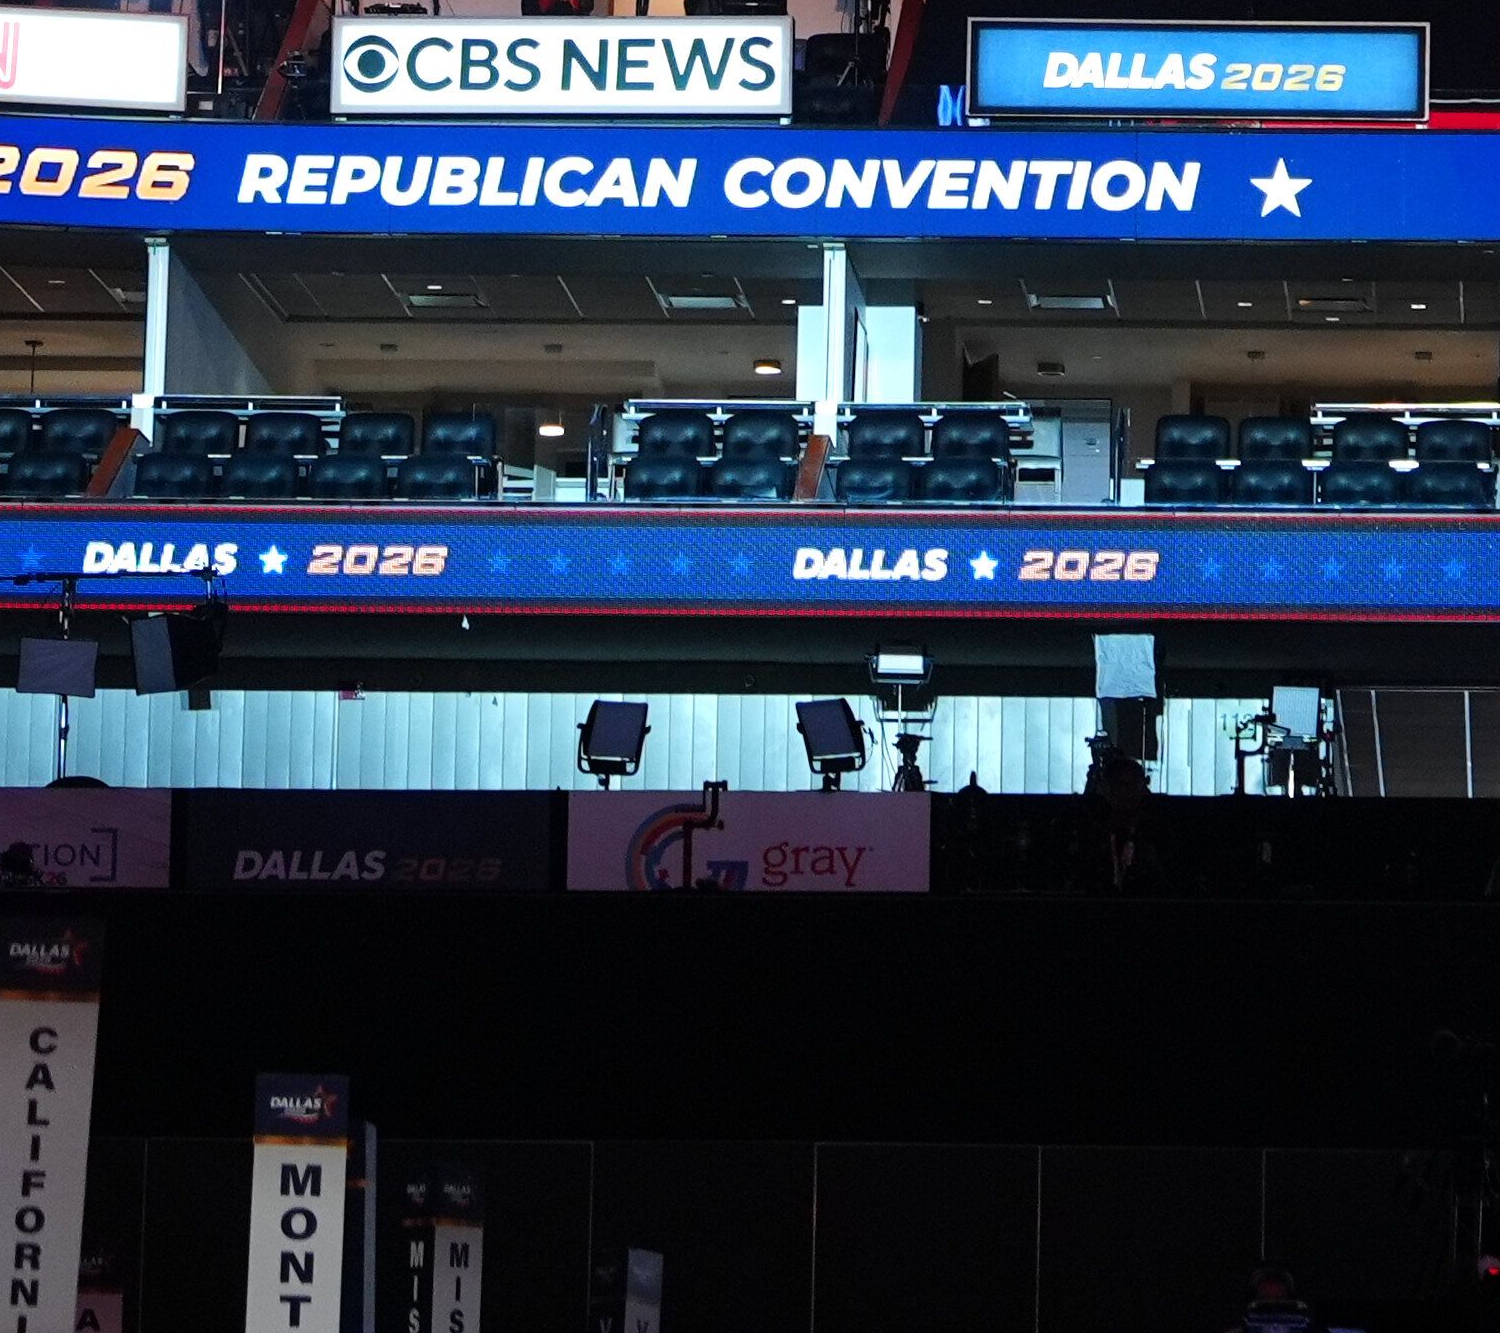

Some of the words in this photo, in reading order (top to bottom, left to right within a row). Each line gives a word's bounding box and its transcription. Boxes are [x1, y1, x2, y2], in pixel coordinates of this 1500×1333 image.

[406, 37, 541, 91] CBS
[561, 37, 775, 91] NEWS
[1044, 52, 1216, 90] DALLAS
[1222, 63, 1346, 93] 2026
[237, 154, 698, 208] REPUBLICAN
[724, 158, 1201, 211] CONVENTION
[83, 542, 238, 575] DALLAS
[307, 545, 448, 575] 2026
[793, 548, 948, 581] DALLAS
[1018, 550, 1159, 581] 2026
[232, 850, 387, 882] DALLAS
[393, 856, 503, 883] 2026
[762, 840, 866, 888] gray
[10, 942, 69, 958] DALLAS
[270, 1096, 322, 1110] DALLAS
